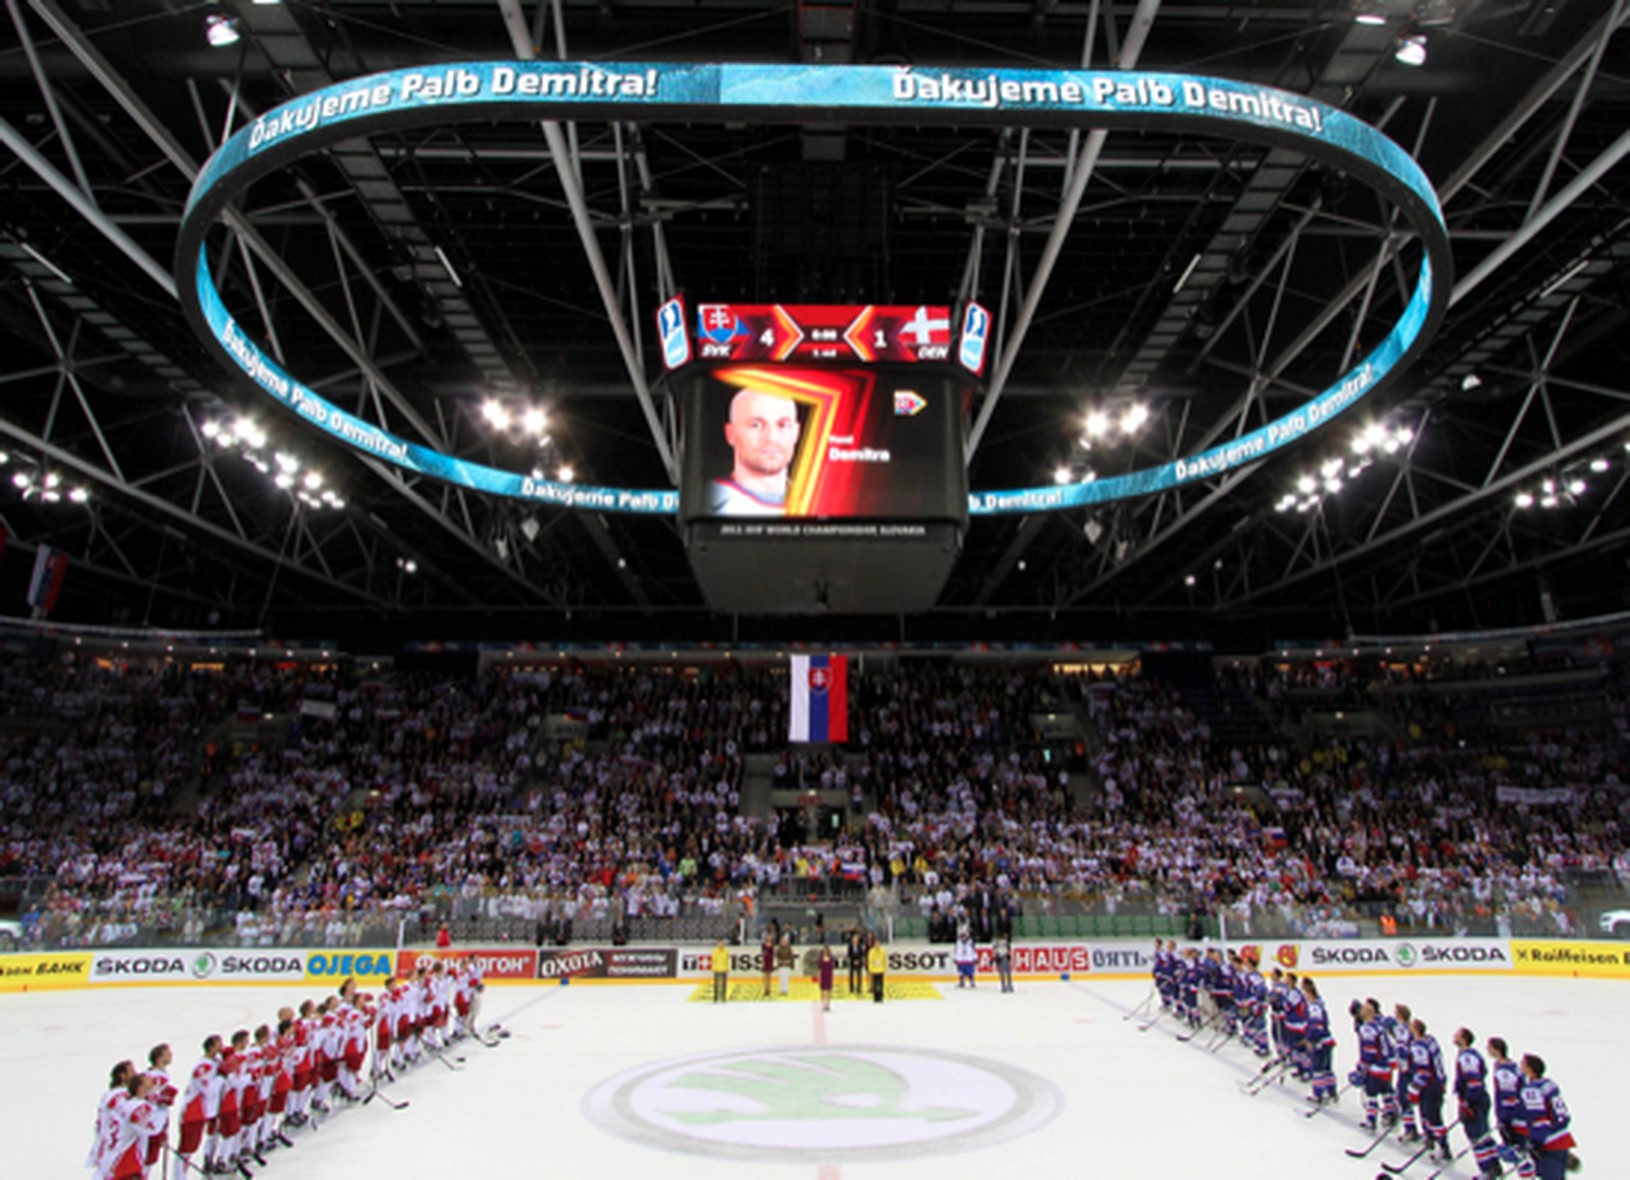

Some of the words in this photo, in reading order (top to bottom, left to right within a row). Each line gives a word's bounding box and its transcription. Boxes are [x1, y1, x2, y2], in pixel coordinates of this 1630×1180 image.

[249, 84, 392, 149] Ďakujeme
[492, 66, 658, 96] Demitra!
[892, 66, 1083, 108] Ďakujeme
[1183, 80, 1323, 132] Demitra!
[760, 329, 774, 346] 4
[874, 330, 887, 348] 1
[702, 343, 731, 357] SVK
[917, 345, 949, 359] DEN
[1308, 362, 1374, 423] Demitra!
[330, 413, 408, 462] Demitra!
[829, 447, 890, 462] Demitra
[1312, 947, 1389, 964] ŠKODA
[1422, 945, 1506, 962] ŠKODA
[1531, 948, 1619, 964] Raiffeisen
[95, 956, 185, 976] ŠKODA
[222, 955, 303, 974] ŠKODA
[307, 954, 392, 976] OJEGA
